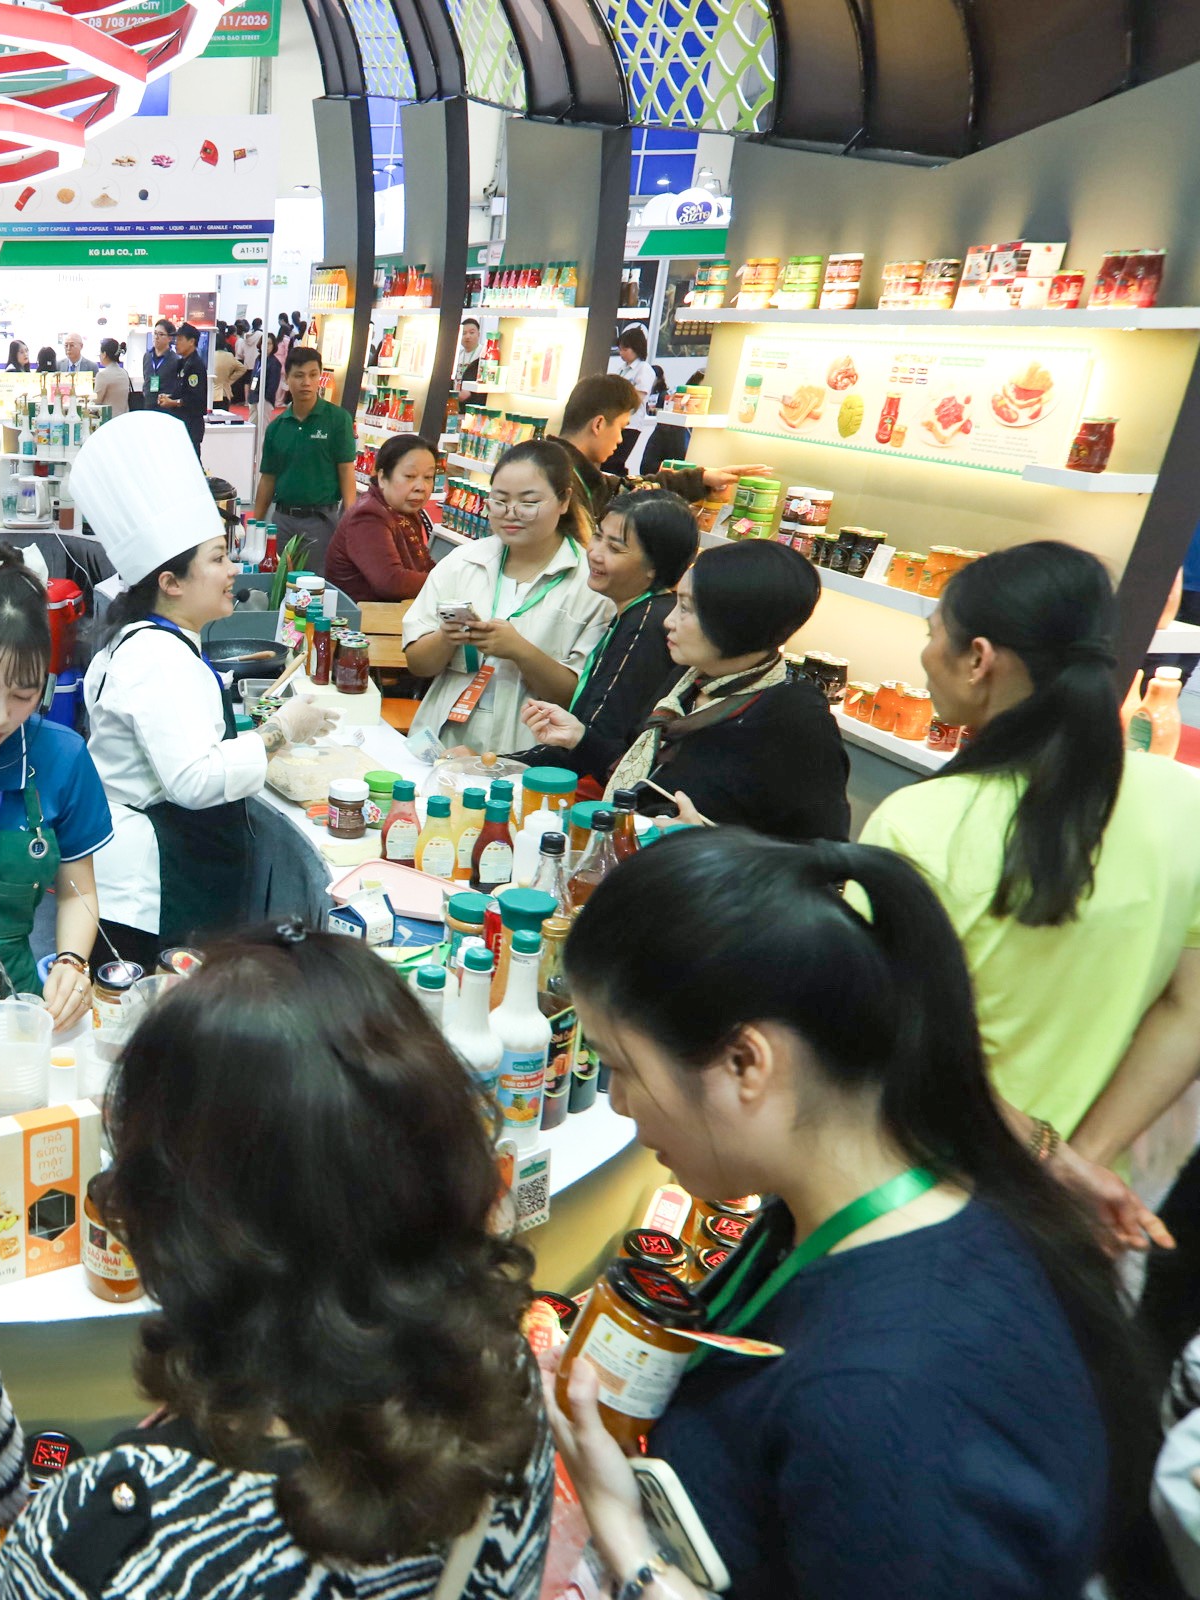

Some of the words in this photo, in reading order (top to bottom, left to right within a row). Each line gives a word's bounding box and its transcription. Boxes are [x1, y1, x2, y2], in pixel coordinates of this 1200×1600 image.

[88, 248, 101, 256] KG
[101, 248, 115, 256] LAB
[43, 1131, 62, 1144] TRÀ
[40, 1168, 64, 1181] ONG
